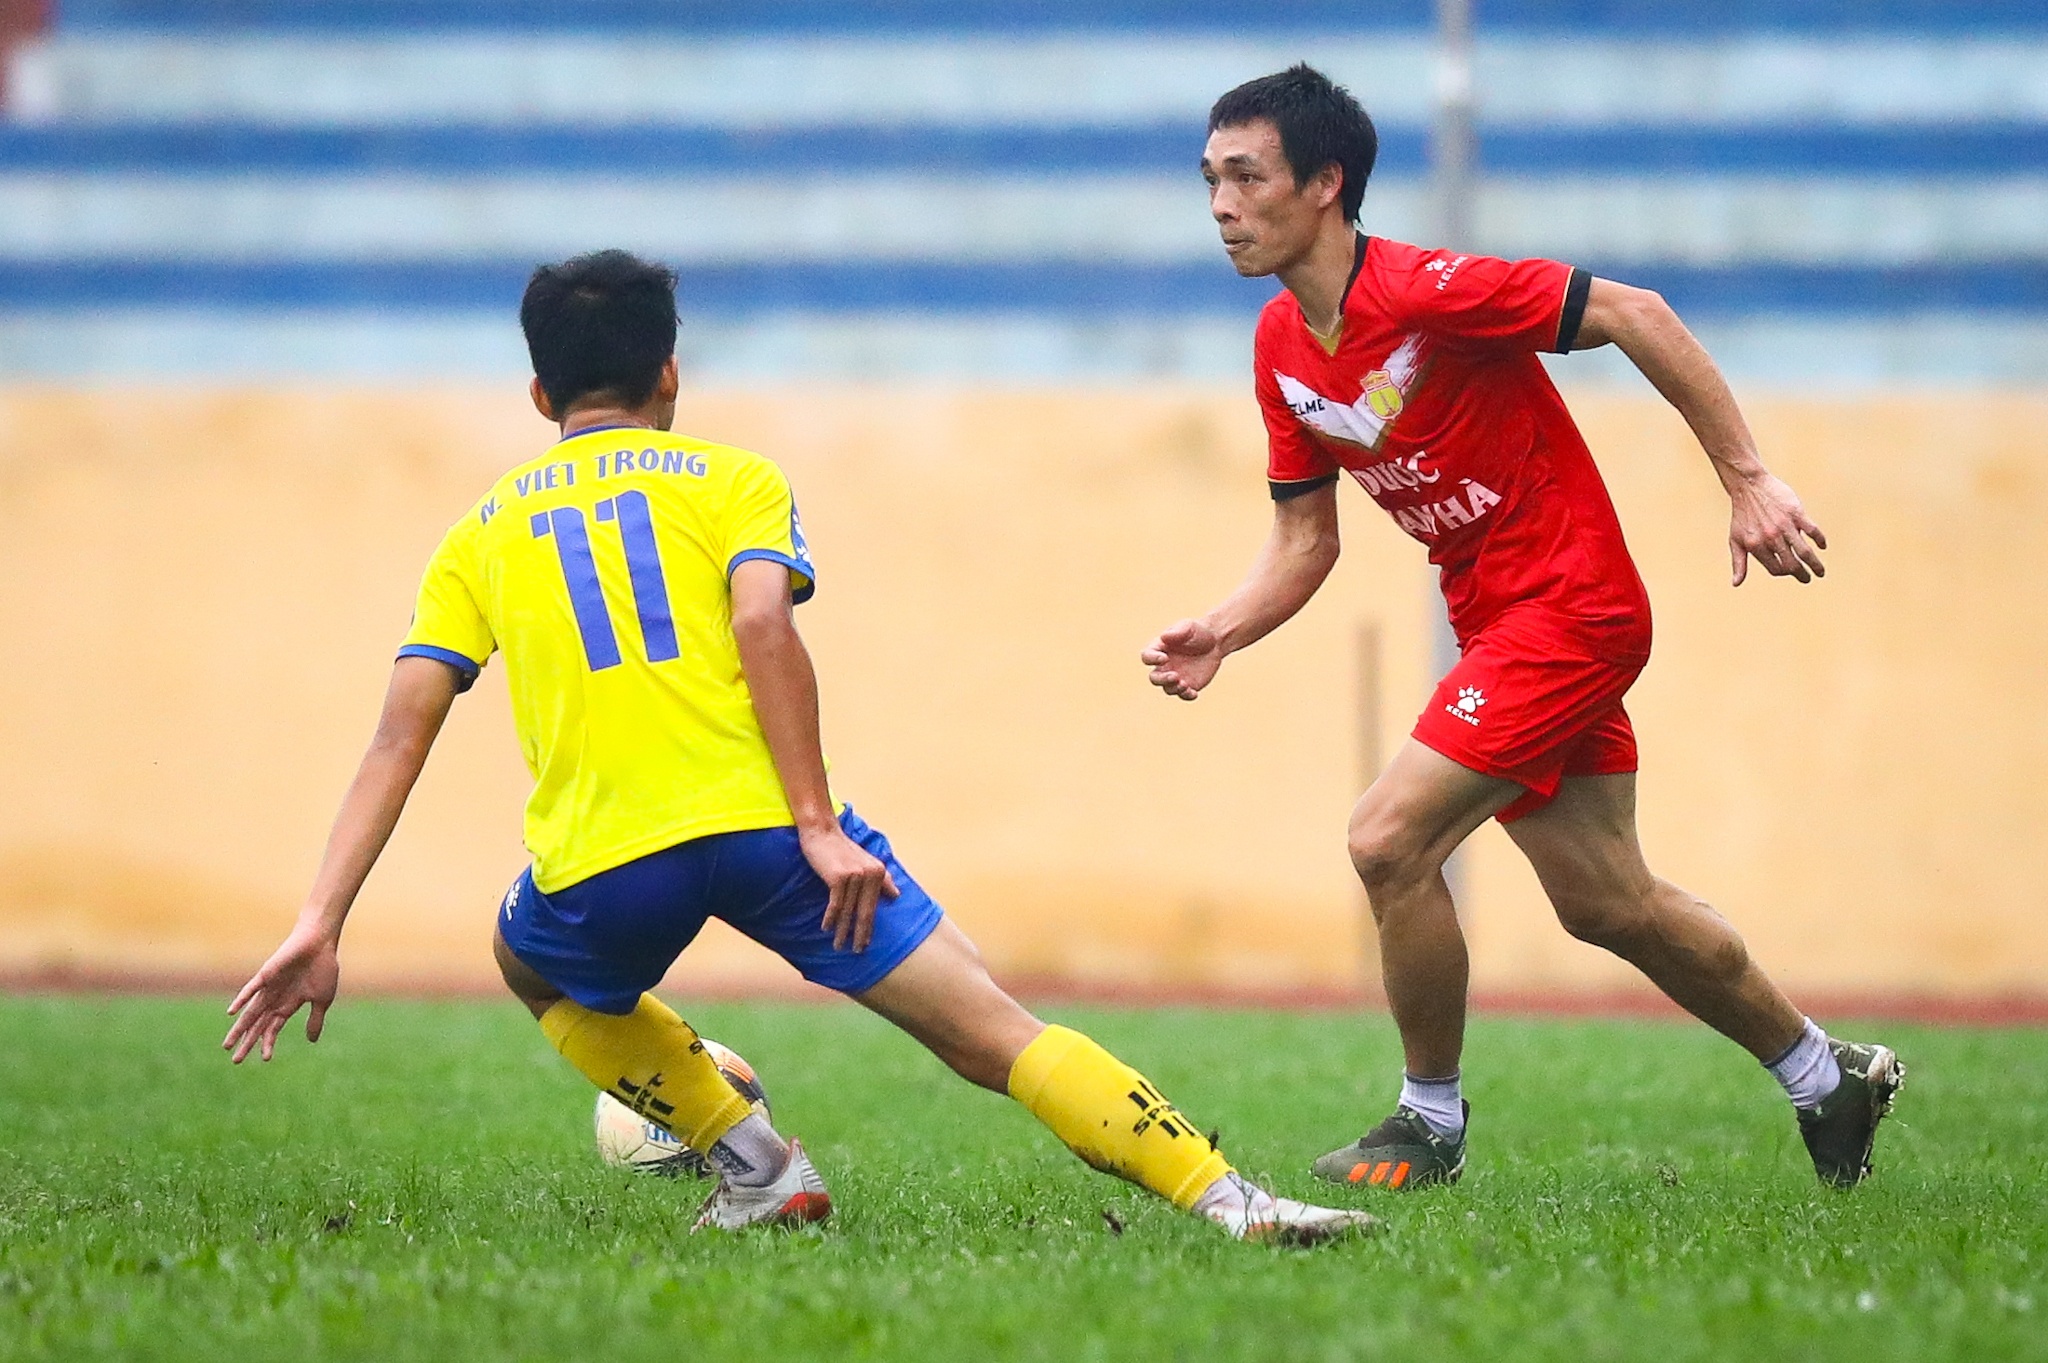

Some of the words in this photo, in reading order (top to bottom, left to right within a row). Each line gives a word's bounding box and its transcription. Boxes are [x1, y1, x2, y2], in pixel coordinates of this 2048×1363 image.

[594, 448, 708, 478] TRONG
[530, 489, 680, 672] 11
[1445, 703, 1481, 727] KELME
